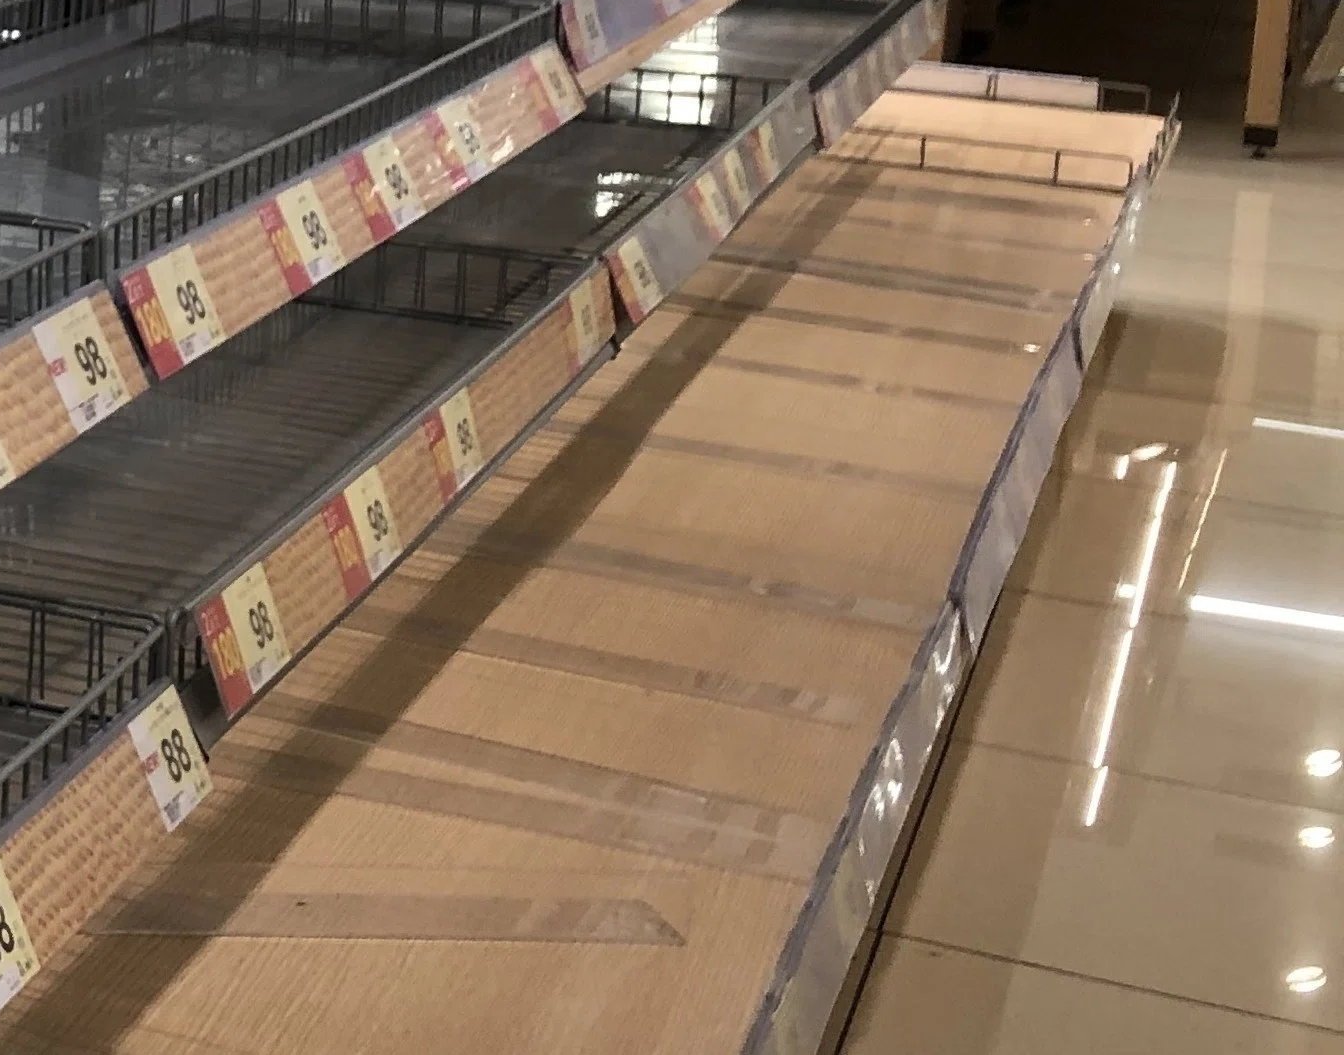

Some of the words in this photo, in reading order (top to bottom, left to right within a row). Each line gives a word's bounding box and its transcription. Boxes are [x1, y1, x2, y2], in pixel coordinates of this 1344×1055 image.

[176, 278, 206, 326] 98
[72, 335, 108, 386] 98
[247, 599, 275, 650] 98
[159, 727, 193, 783] 88
